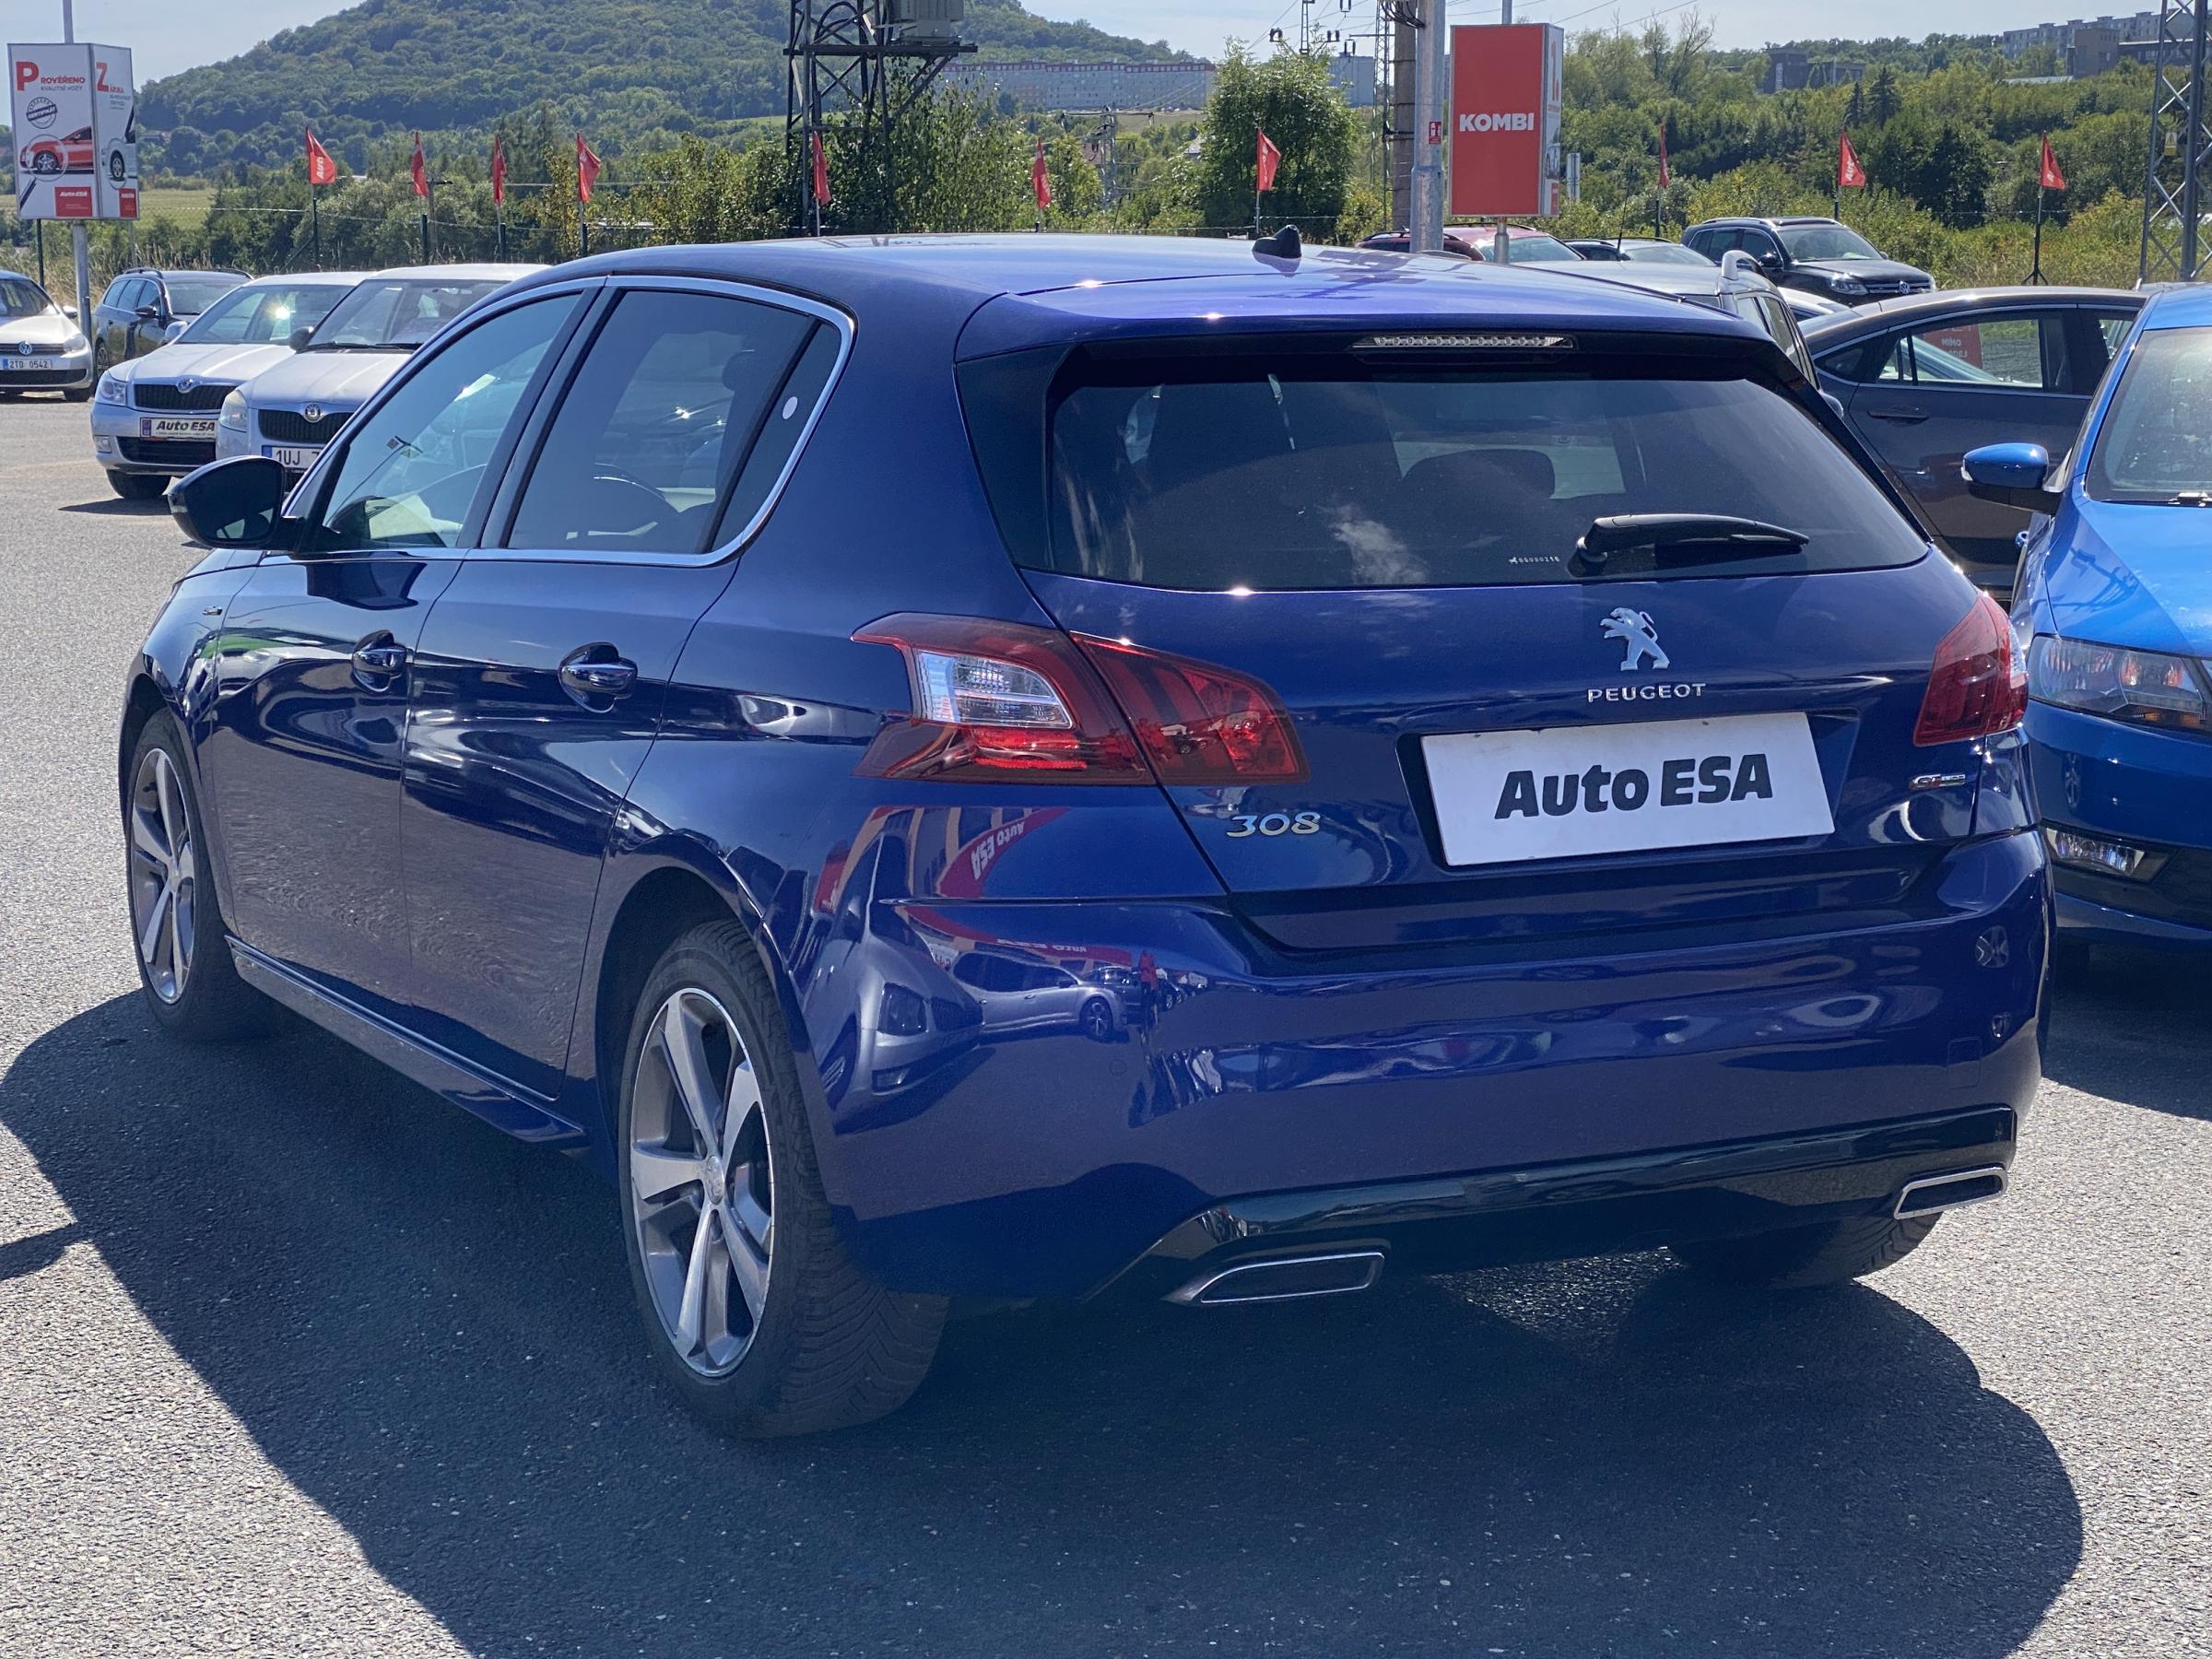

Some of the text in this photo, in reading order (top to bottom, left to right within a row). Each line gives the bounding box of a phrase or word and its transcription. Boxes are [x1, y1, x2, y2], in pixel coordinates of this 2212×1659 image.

[1459, 112, 1535, 132] KOMBI
[156, 420, 215, 431] Auto ESA
[276, 449, 300, 465] 1UJ
[1587, 683, 1706, 703] PEUGEOT
[1494, 753, 1773, 819] Auto ESA
[1226, 811, 1321, 838] 308
